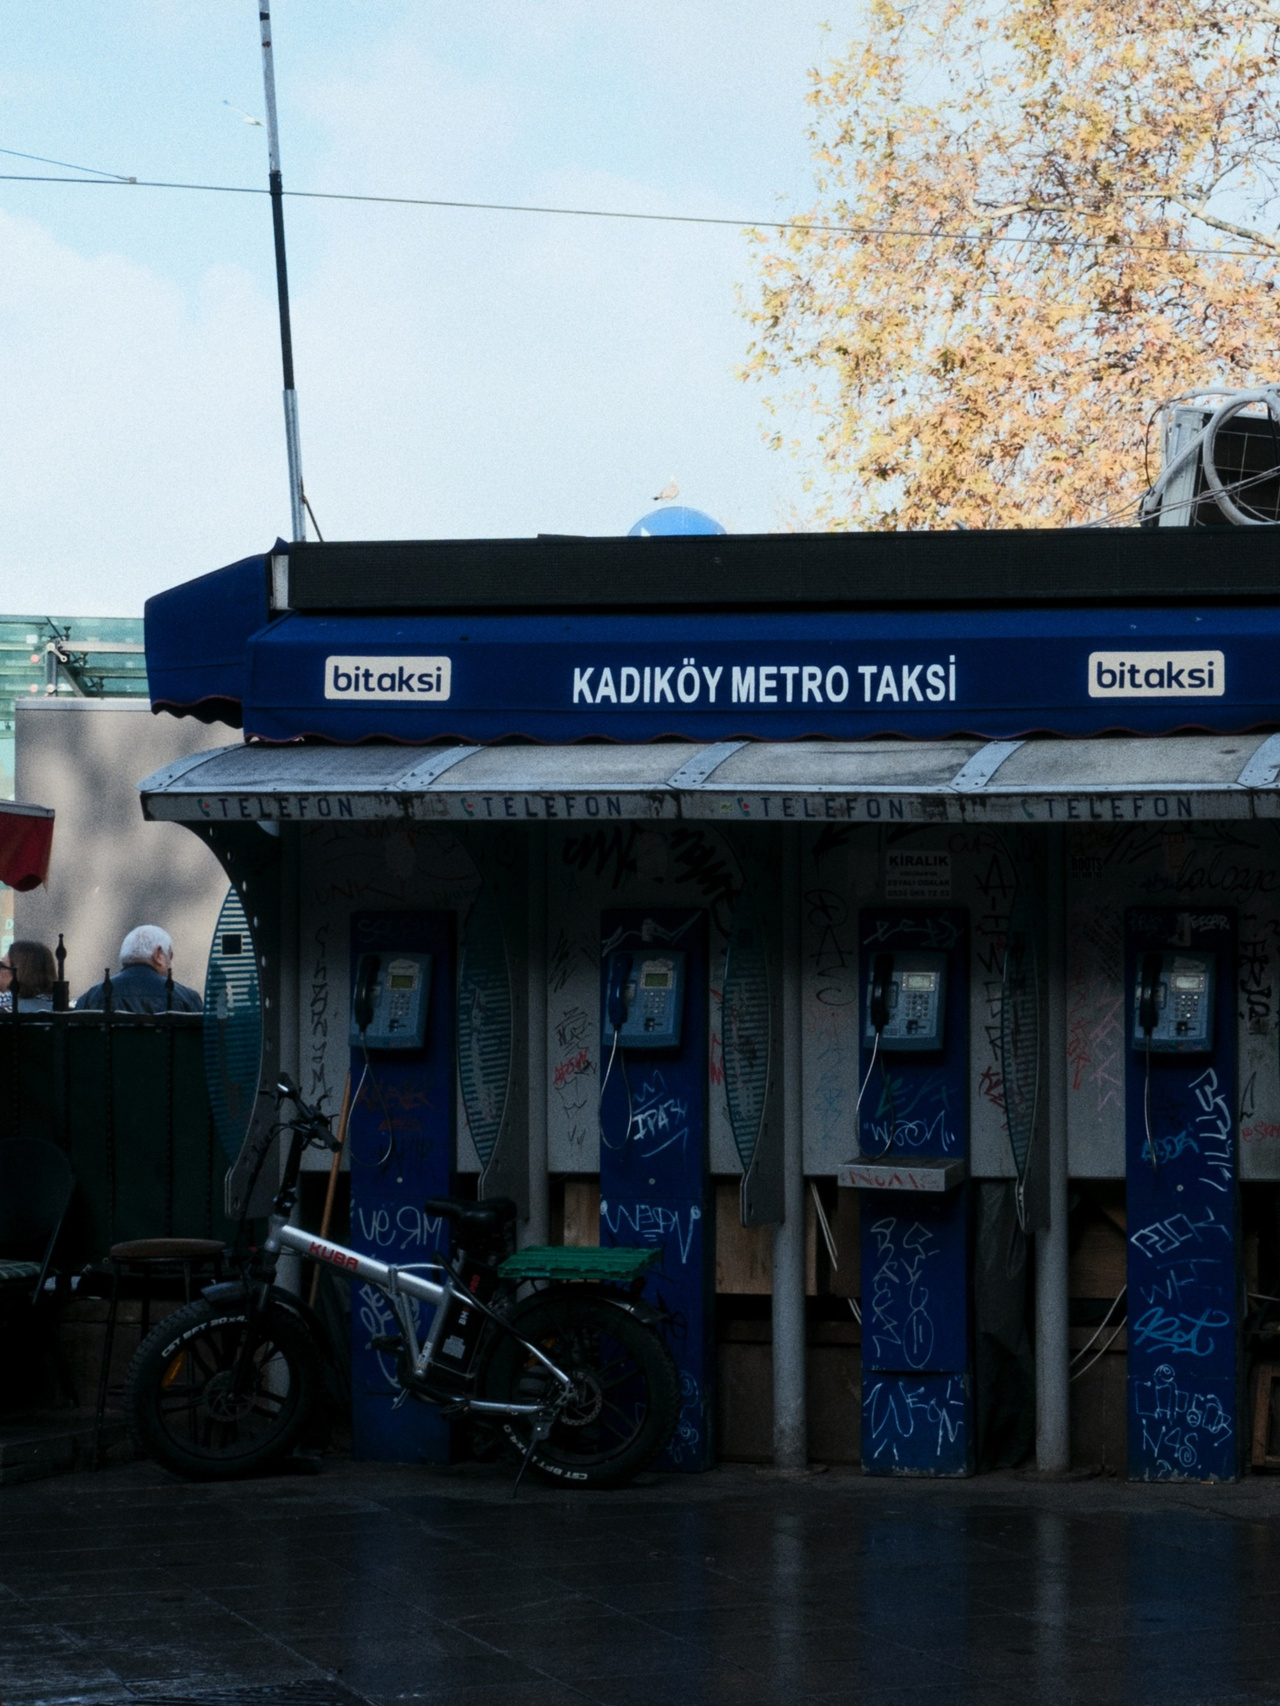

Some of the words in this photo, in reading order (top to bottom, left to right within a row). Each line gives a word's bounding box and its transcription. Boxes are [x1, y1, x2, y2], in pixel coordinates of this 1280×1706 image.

[333, 665, 442, 693] bitaksi
[572, 657, 724, 704] KADIKÖY
[731, 665, 849, 704] METRO
[857, 654, 956, 704] TAKSİ
[1096, 660, 1215, 689] bitaksi
[217, 797, 355, 819] TELEFON
[480, 796, 622, 818] TELEFON
[760, 796, 904, 818] TELEFON
[1044, 796, 1193, 818] TELEFON
[309, 1240, 359, 1270] KUBA
